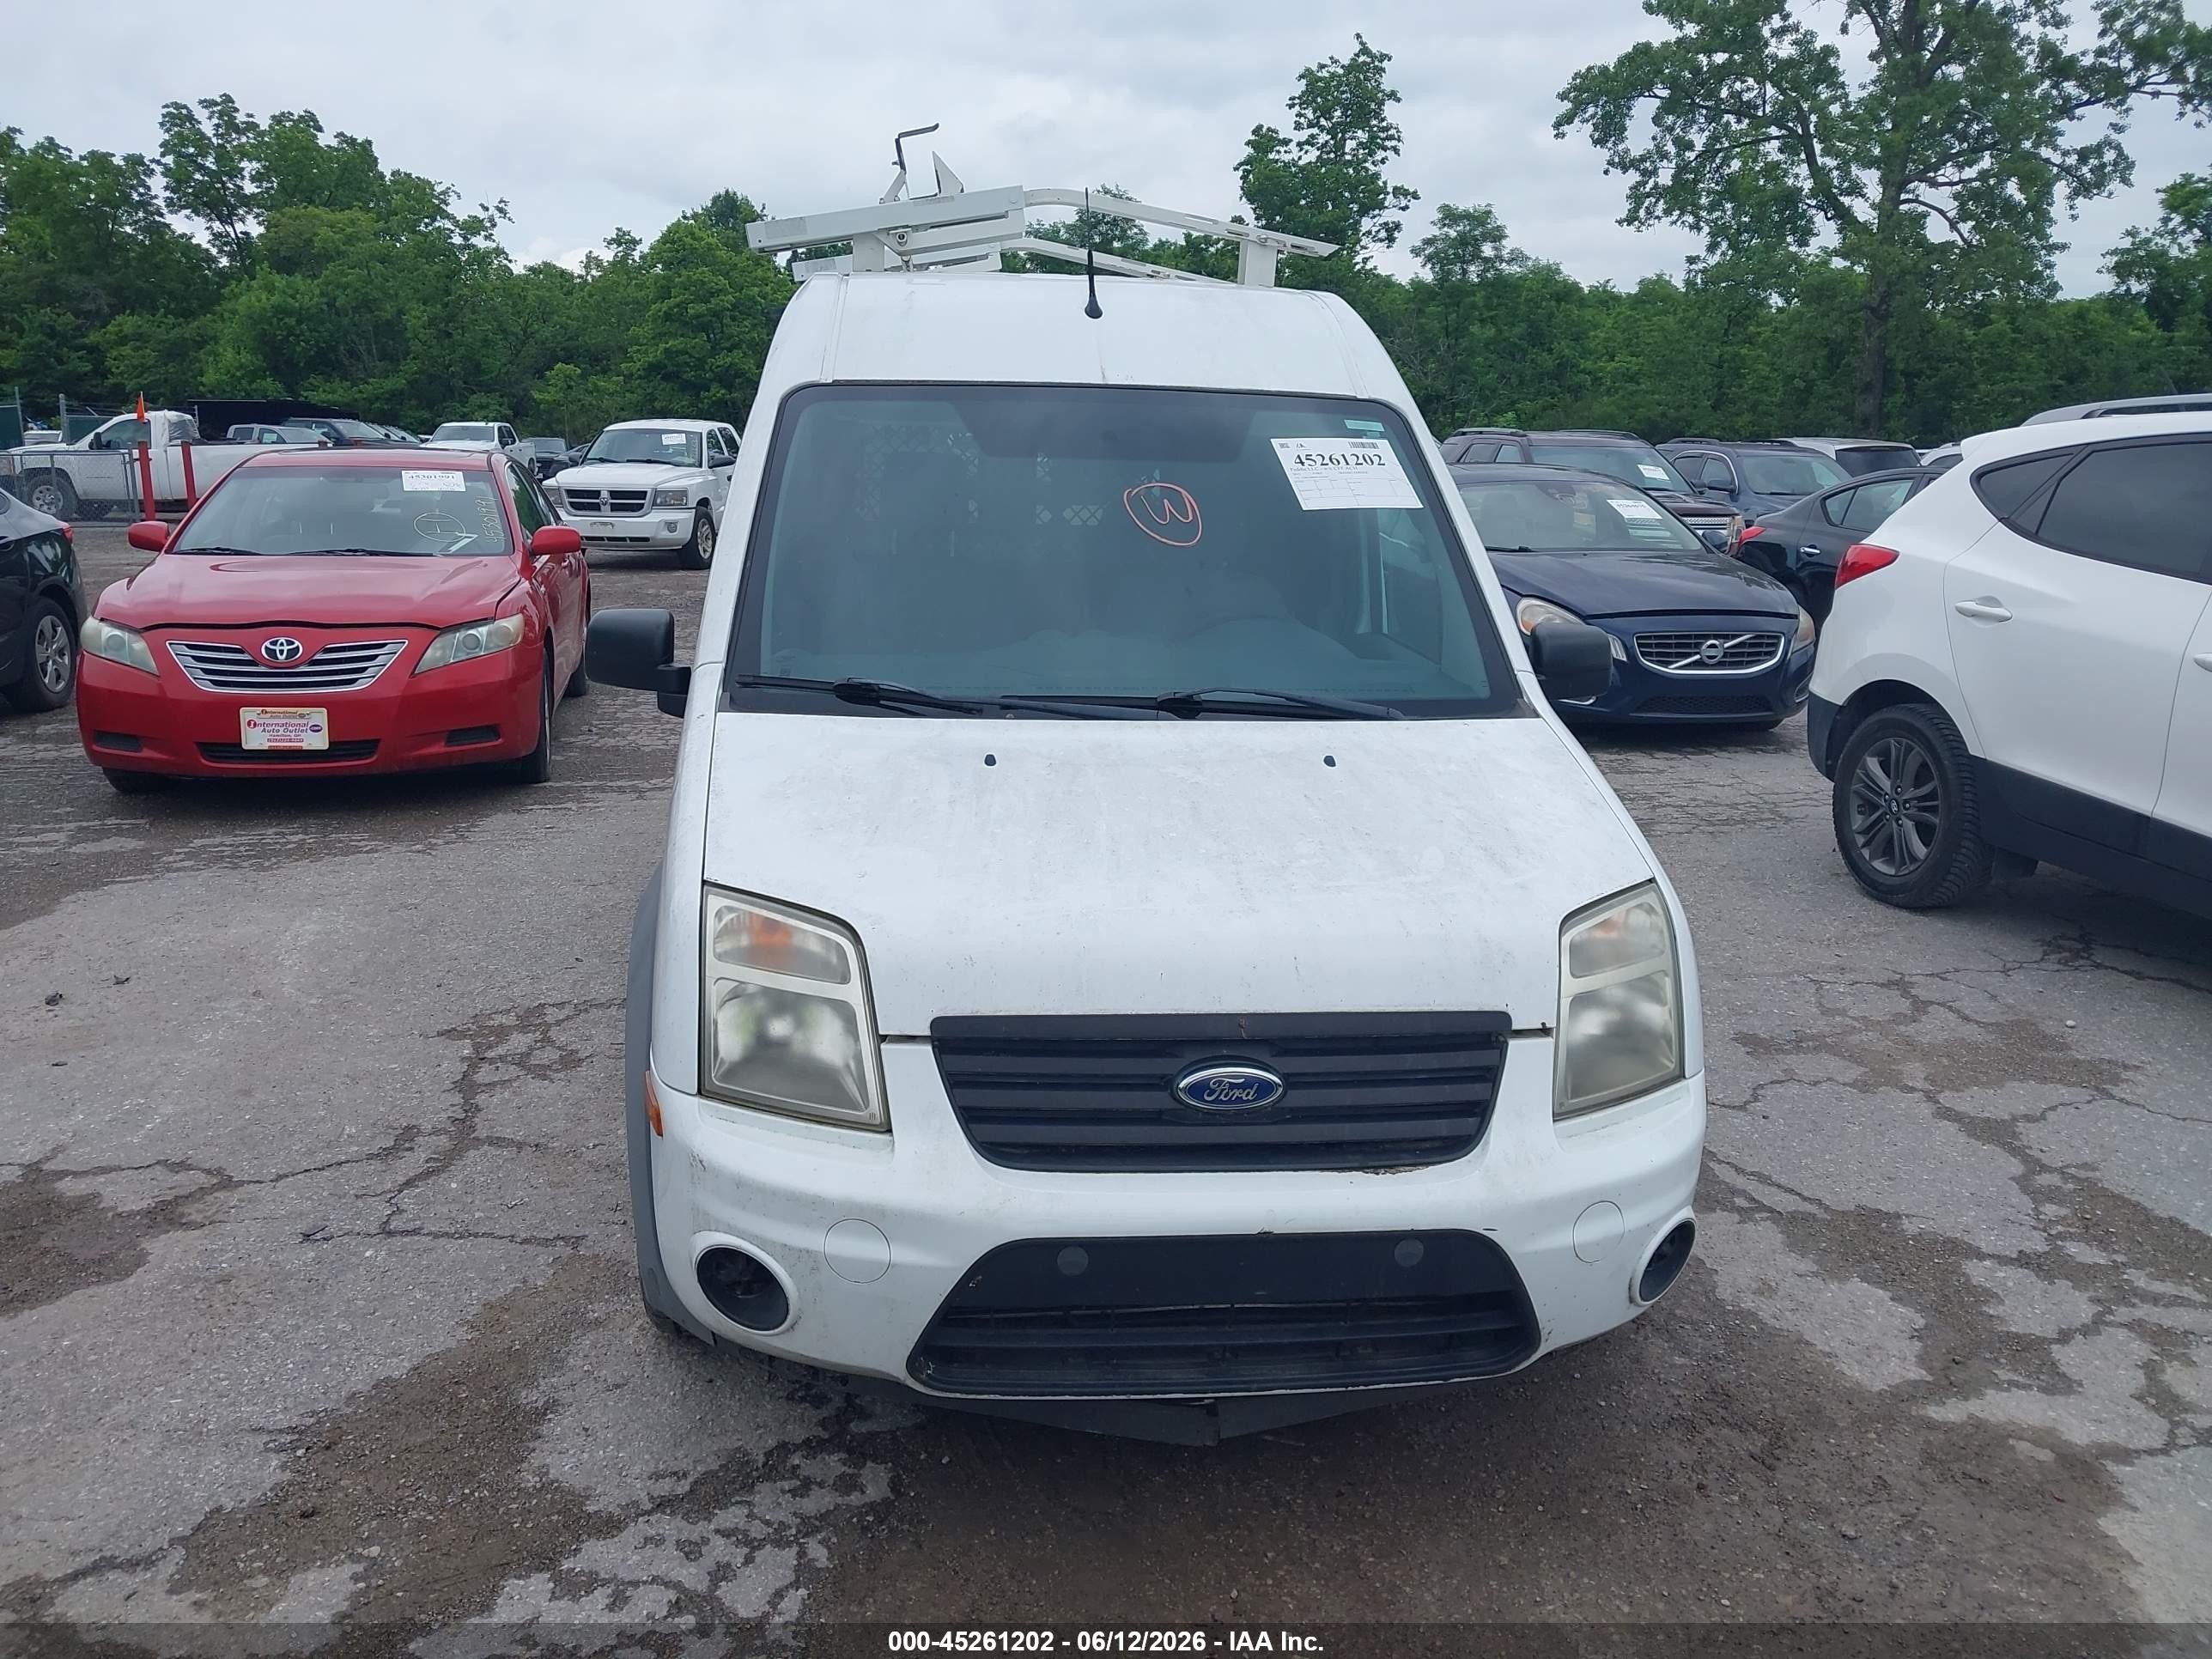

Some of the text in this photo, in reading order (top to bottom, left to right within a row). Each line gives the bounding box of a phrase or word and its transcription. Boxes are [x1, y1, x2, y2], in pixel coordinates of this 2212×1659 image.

[1294, 453, 1386, 466] 45261202
[474, 495, 508, 544] 45301991
[247, 719, 309, 729] International
[1203, 1078, 1260, 1101] Ford
